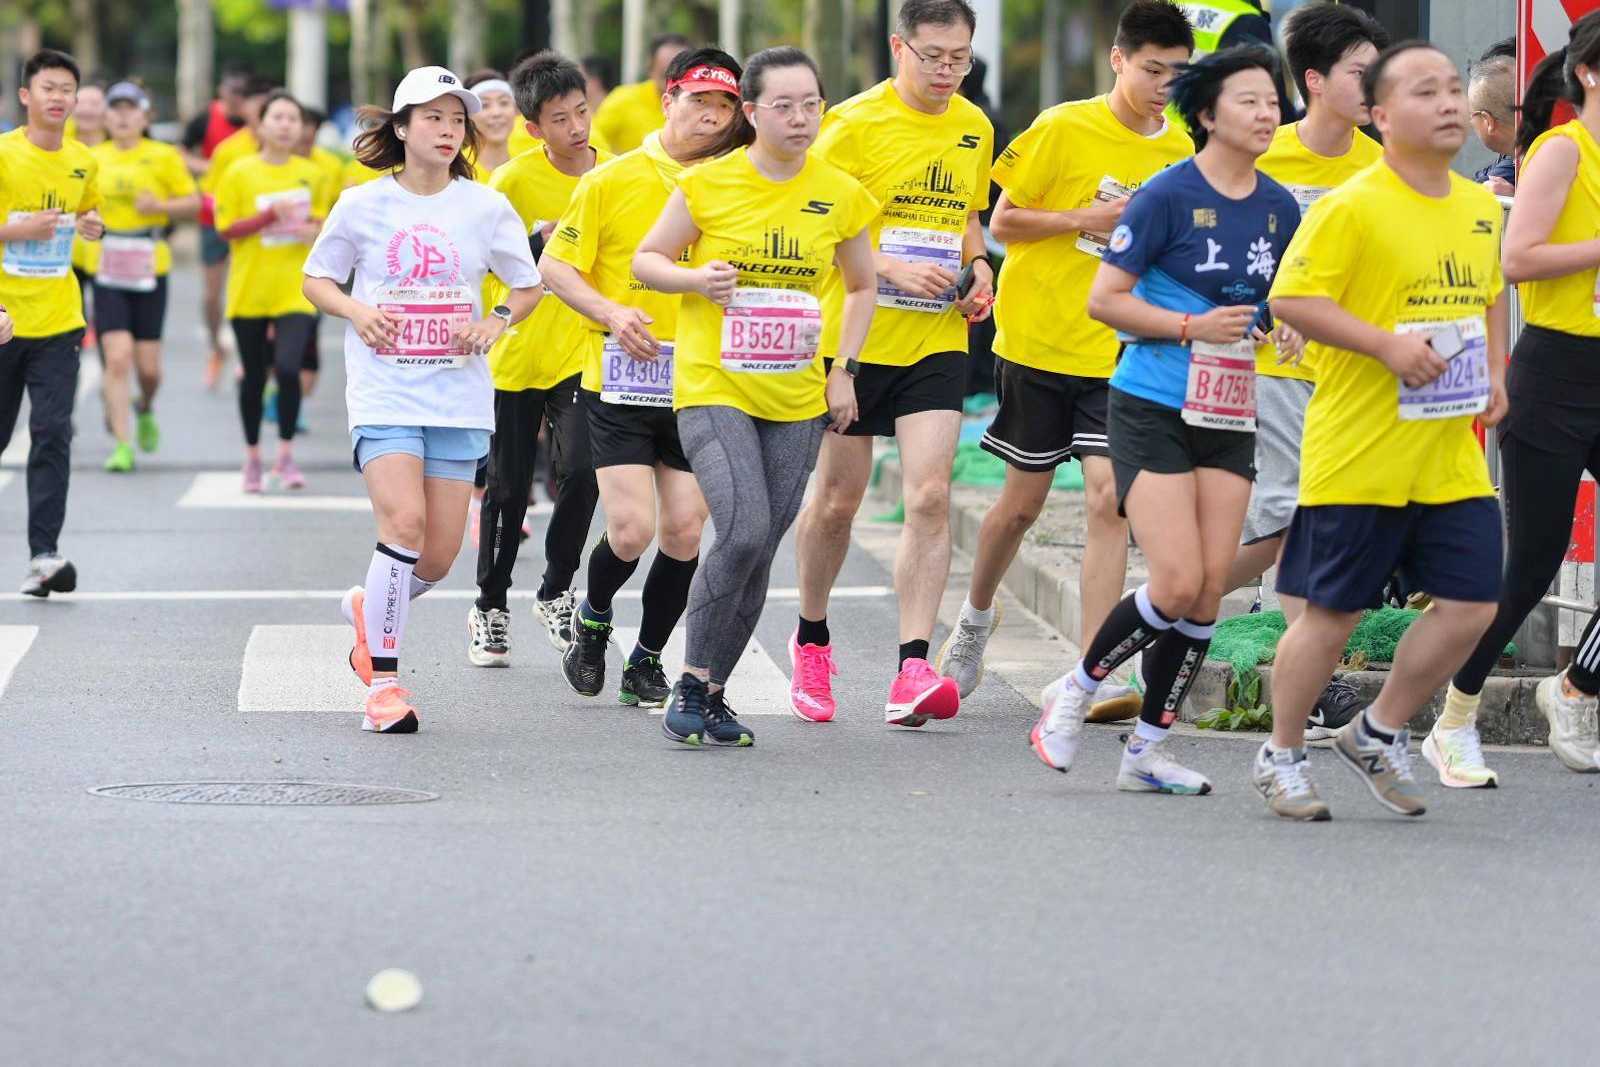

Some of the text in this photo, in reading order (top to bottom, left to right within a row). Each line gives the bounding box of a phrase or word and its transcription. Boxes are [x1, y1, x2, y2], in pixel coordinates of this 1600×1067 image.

[891, 194, 968, 211] SKECHERS
[1194, 237, 1276, 282] 上海
[727, 260, 818, 278] SKECHERS
[893, 298, 943, 310] SKECHERS
[1406, 295, 1487, 306] SKECHERS
[386, 318, 450, 346] 4766
[731, 320, 797, 350] B5521
[395, 357, 453, 366] SKECHERS
[609, 355, 671, 385] B4304
[740, 362, 797, 371] SKECHERS
[1196, 369, 1249, 406] B4756
[618, 393, 673, 405] SKECHERS
[1422, 402, 1478, 414] SKECHERS
